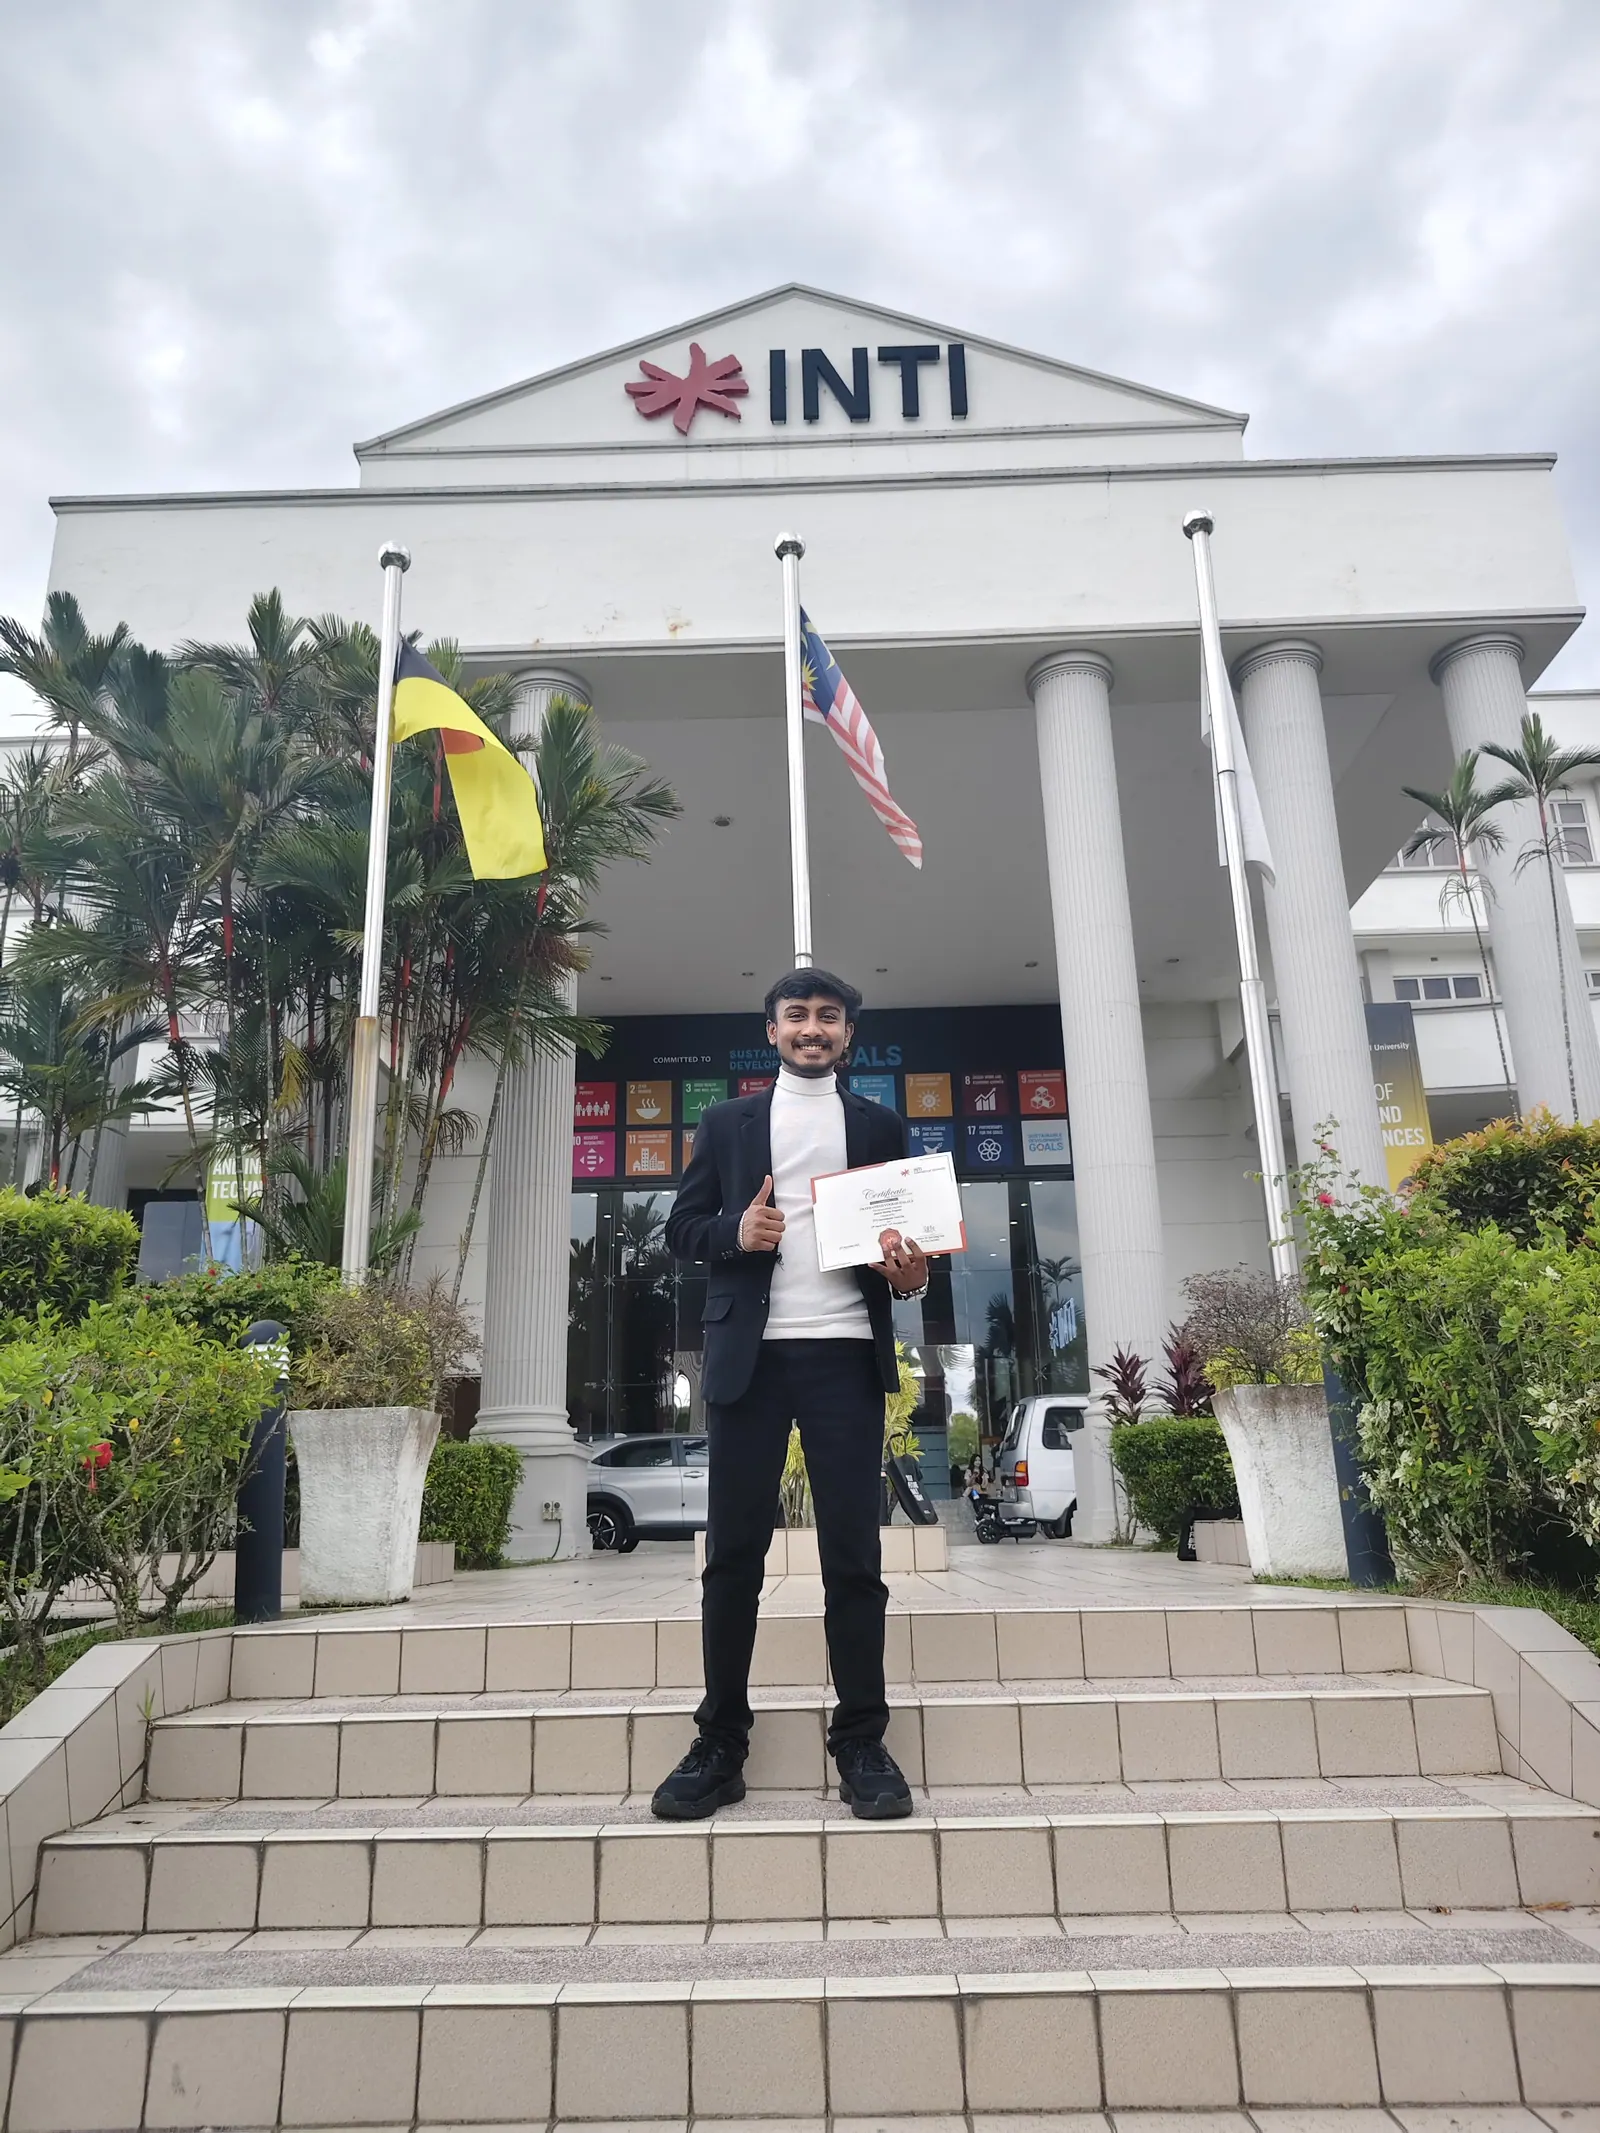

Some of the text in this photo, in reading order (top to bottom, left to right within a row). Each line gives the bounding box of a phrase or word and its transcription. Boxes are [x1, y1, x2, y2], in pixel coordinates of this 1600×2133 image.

[769, 344, 968, 423] INTI
[1374, 1042, 1410, 1051] University
[653, 1056, 698, 1064] COMMITTED
[852, 1078, 859, 1089] 6
[964, 1075, 971, 1085] 8
[1020, 1073, 1027, 1084] 9
[629, 1085, 636, 1094] 2
[685, 1083, 692, 1093] 3
[741, 1082, 748, 1091] 4
[1374, 1083, 1394, 1102] OF
[1378, 1105, 1402, 1124] ND
[910, 1127, 920, 1137] 16
[967, 1125, 976, 1136] 17
[628, 1134, 637, 1145] 11
[685, 1133, 695, 1143] 12
[1029, 1143, 1064, 1152] GOALS
[213, 1158, 238, 1175] AN
[862, 1187, 906, 1199] Certificate
